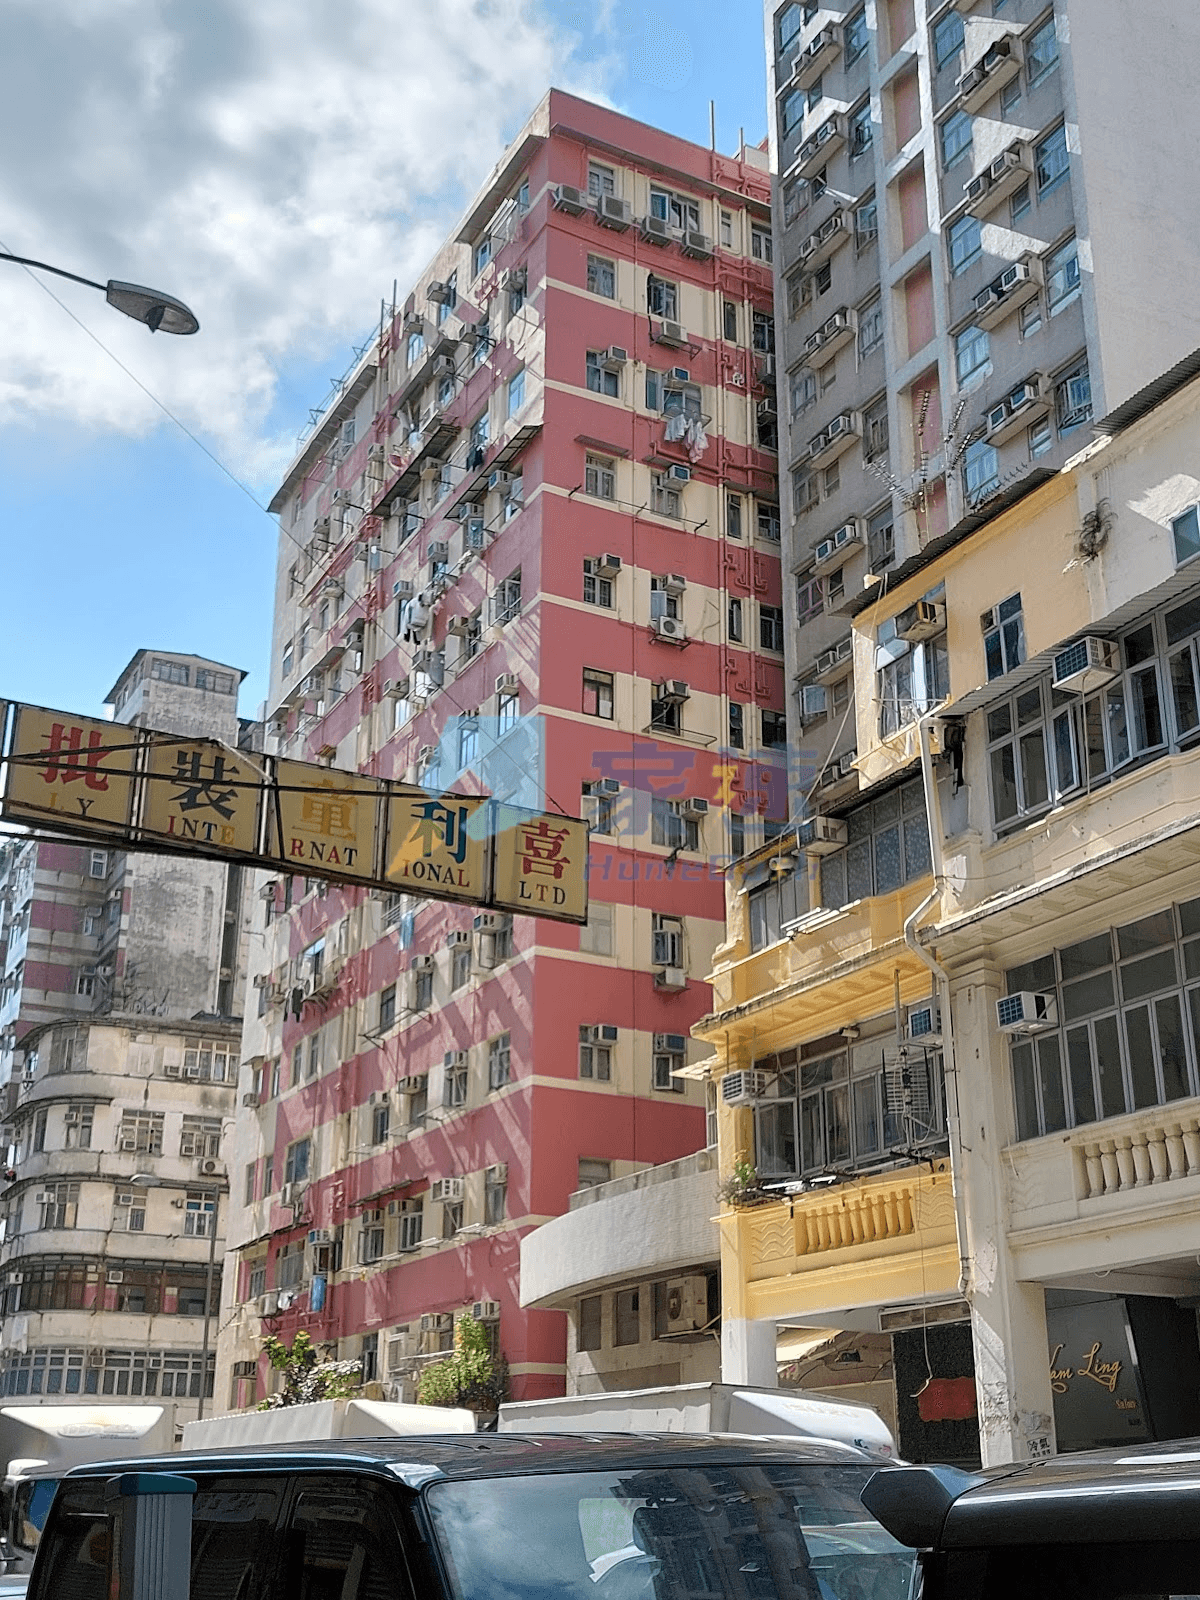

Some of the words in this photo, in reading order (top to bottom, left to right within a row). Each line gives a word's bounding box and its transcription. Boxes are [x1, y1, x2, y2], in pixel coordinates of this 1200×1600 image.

[515, 821, 570, 880] 喜
[519, 880, 566, 905] LTD
[1077, 1342, 1122, 1392] Ling
